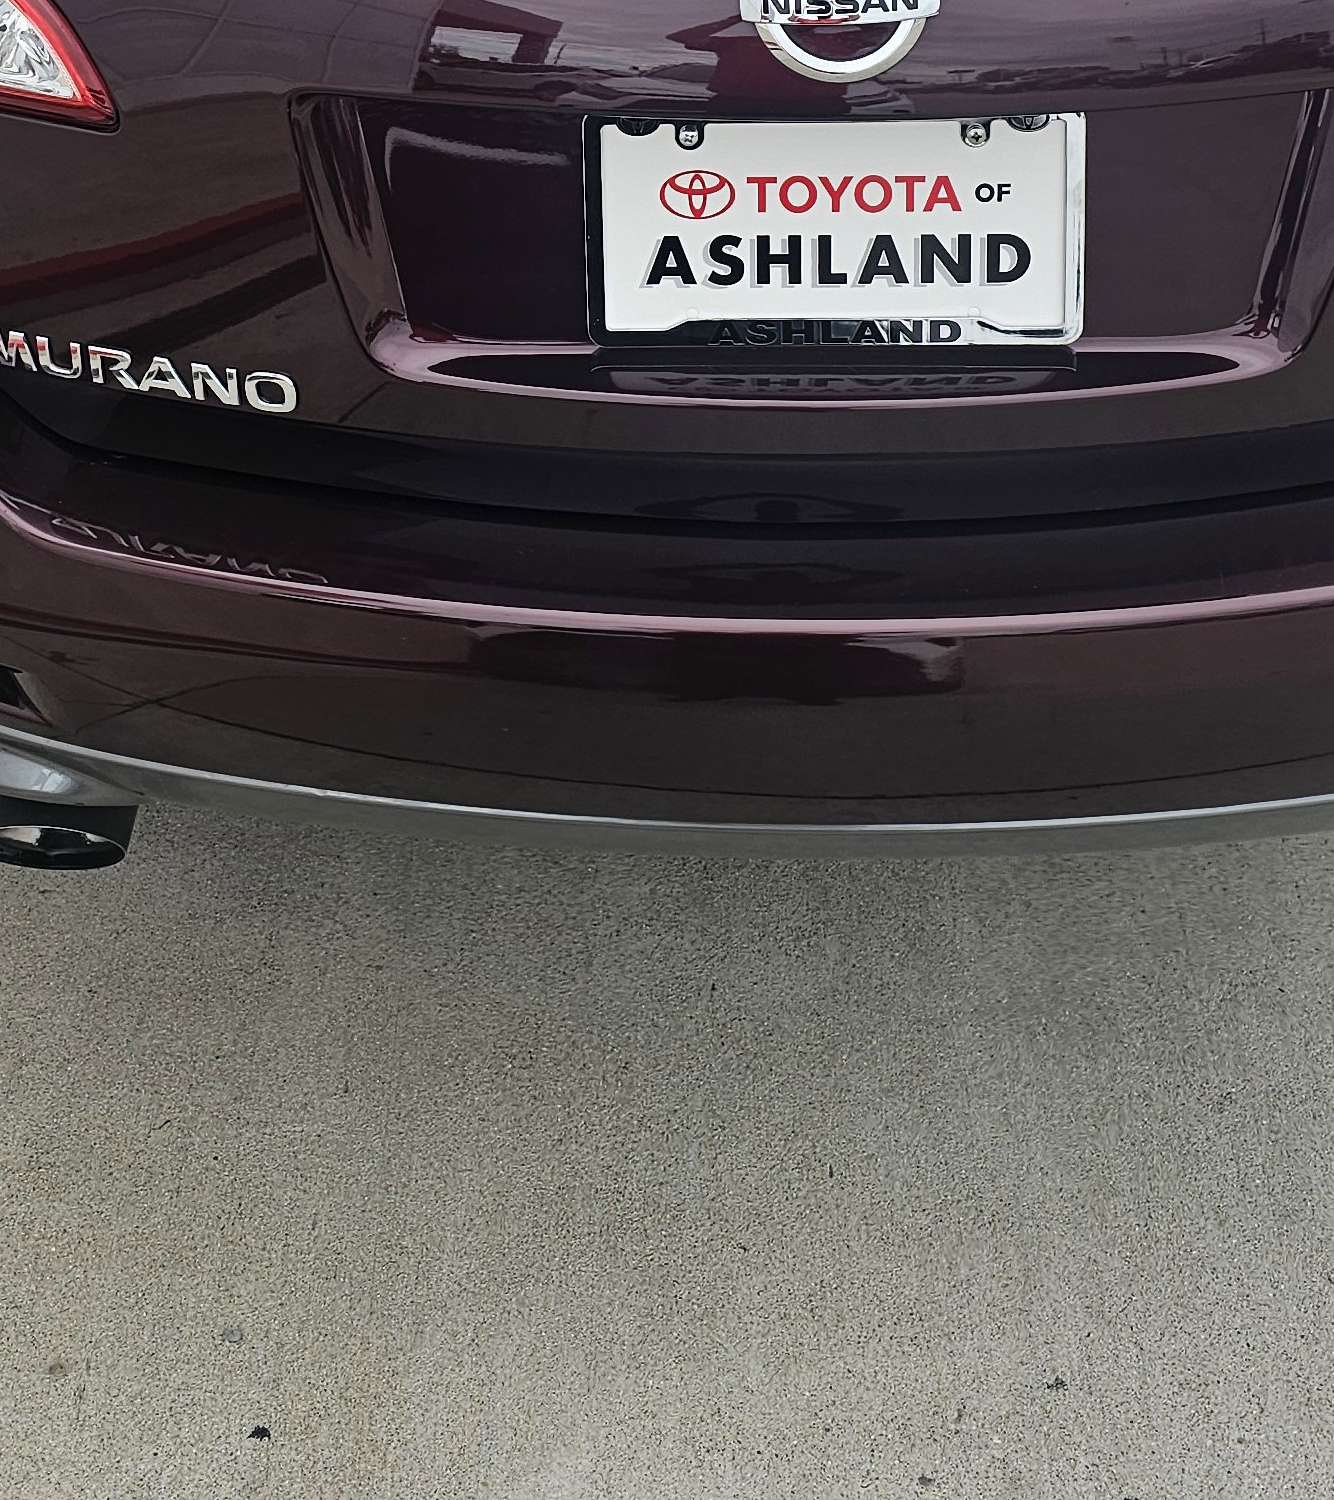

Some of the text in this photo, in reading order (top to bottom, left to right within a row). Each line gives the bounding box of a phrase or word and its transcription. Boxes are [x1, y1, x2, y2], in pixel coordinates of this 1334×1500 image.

[746, 175, 1011, 213] TOYOTA OF
[642, 233, 1032, 287] ASHLAND
[708, 319, 963, 345] ASHLAND
